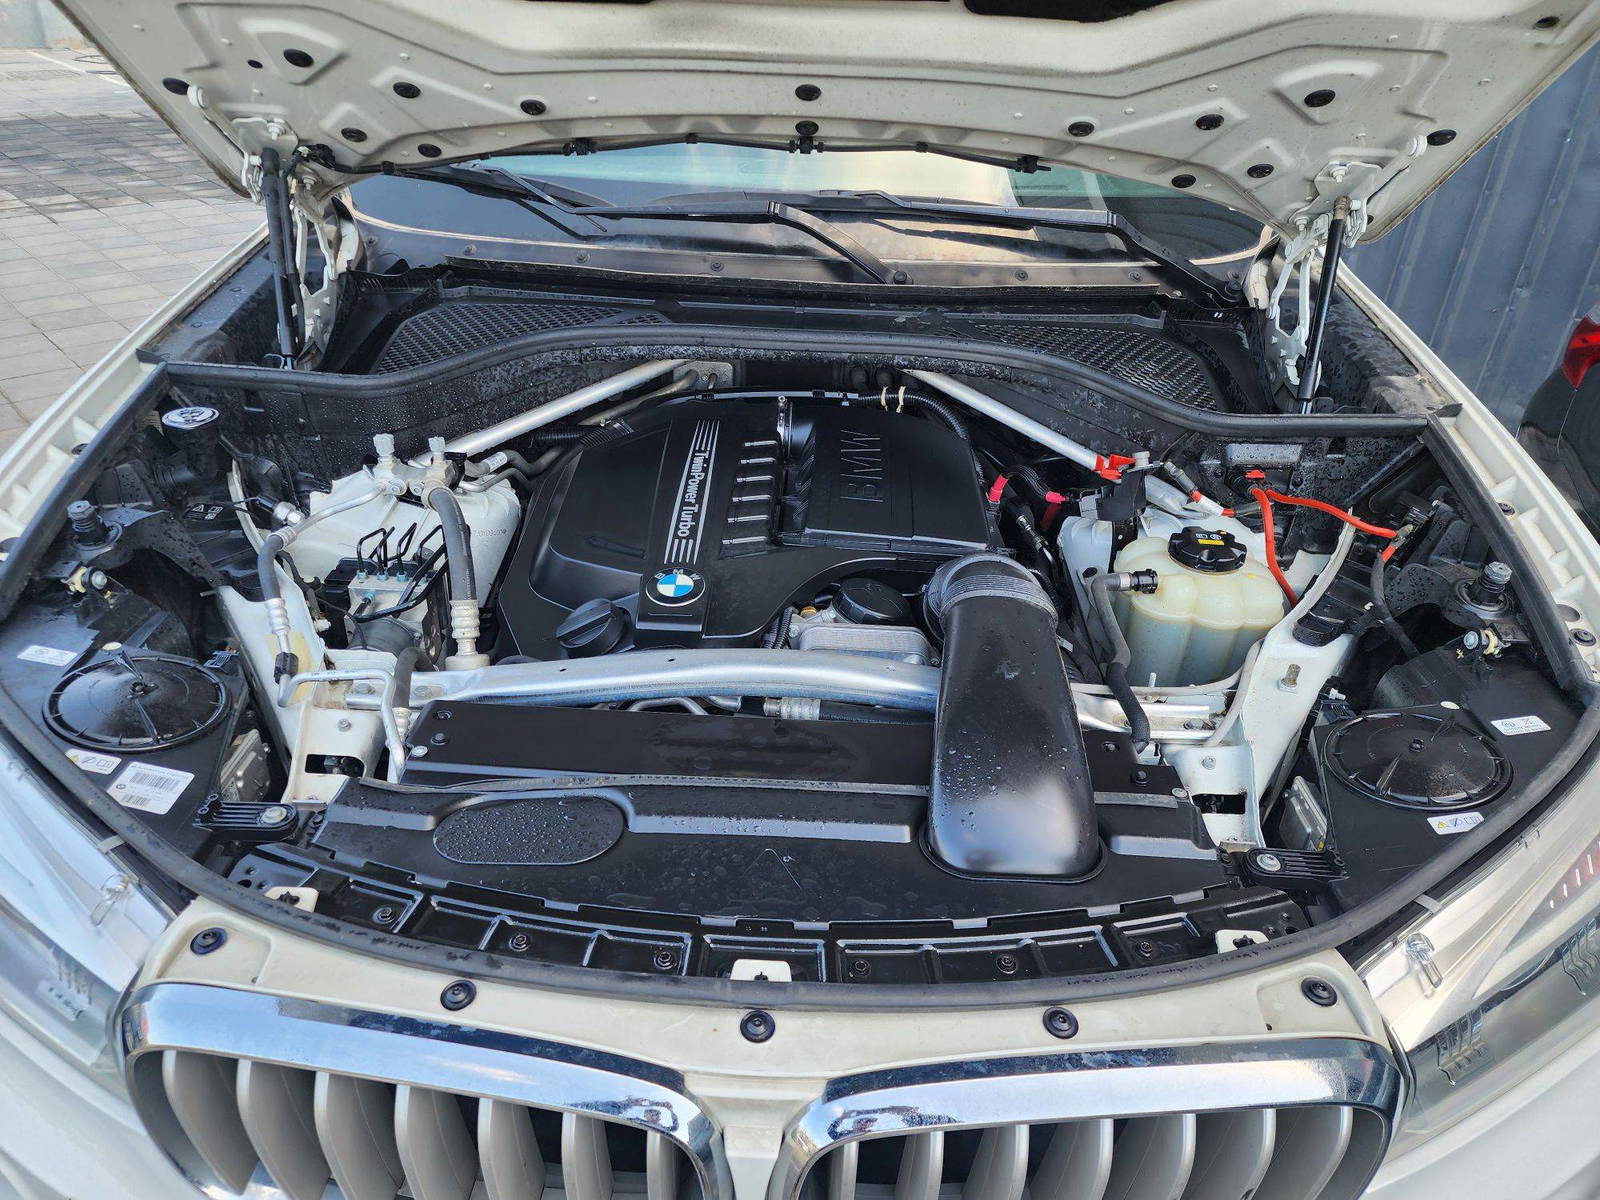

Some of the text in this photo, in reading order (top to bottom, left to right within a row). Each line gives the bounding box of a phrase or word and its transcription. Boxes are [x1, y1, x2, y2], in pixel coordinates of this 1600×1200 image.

[677, 450, 708, 537] TwinPower Turbo
[840, 429, 883, 503] BMW
